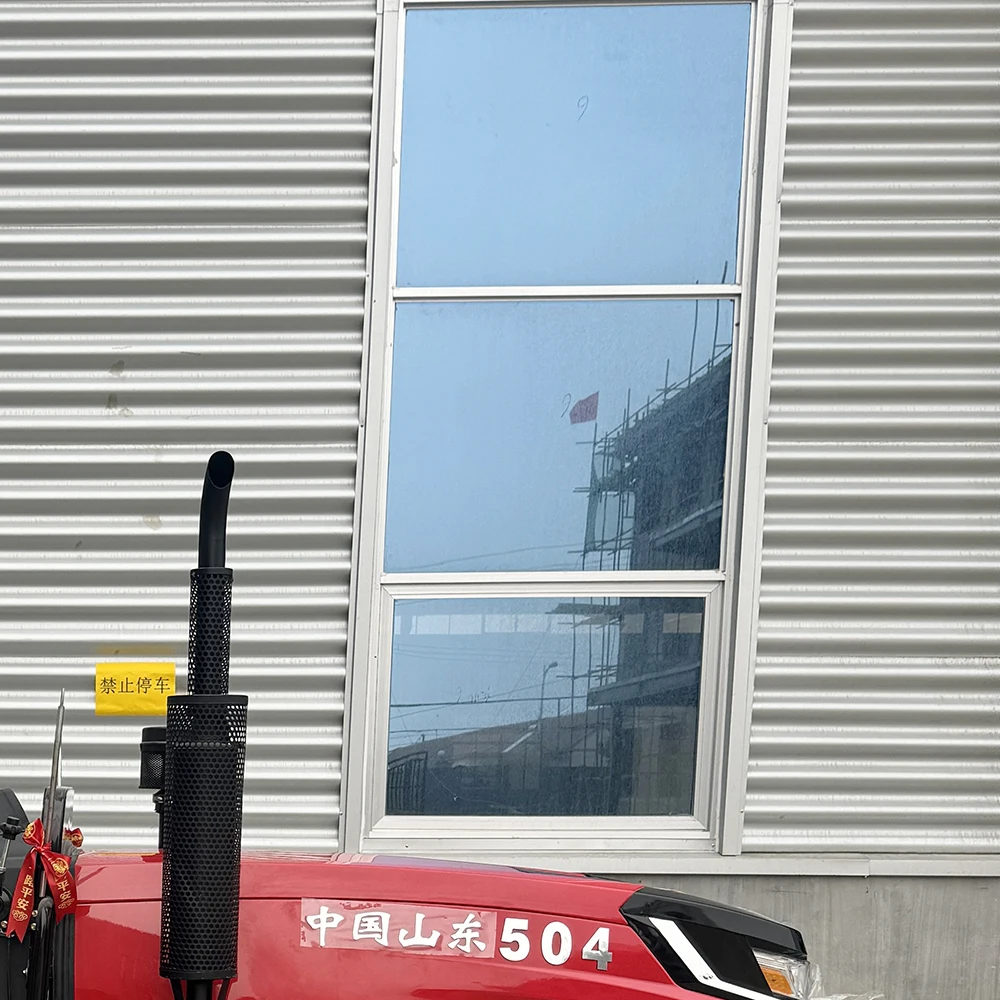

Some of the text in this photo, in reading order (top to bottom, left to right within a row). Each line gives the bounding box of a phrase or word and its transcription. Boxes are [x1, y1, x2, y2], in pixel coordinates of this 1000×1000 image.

[100, 677, 170, 694] 禁止停车
[306, 906, 486, 953] 中国山东
[499, 917, 613, 970] 504
